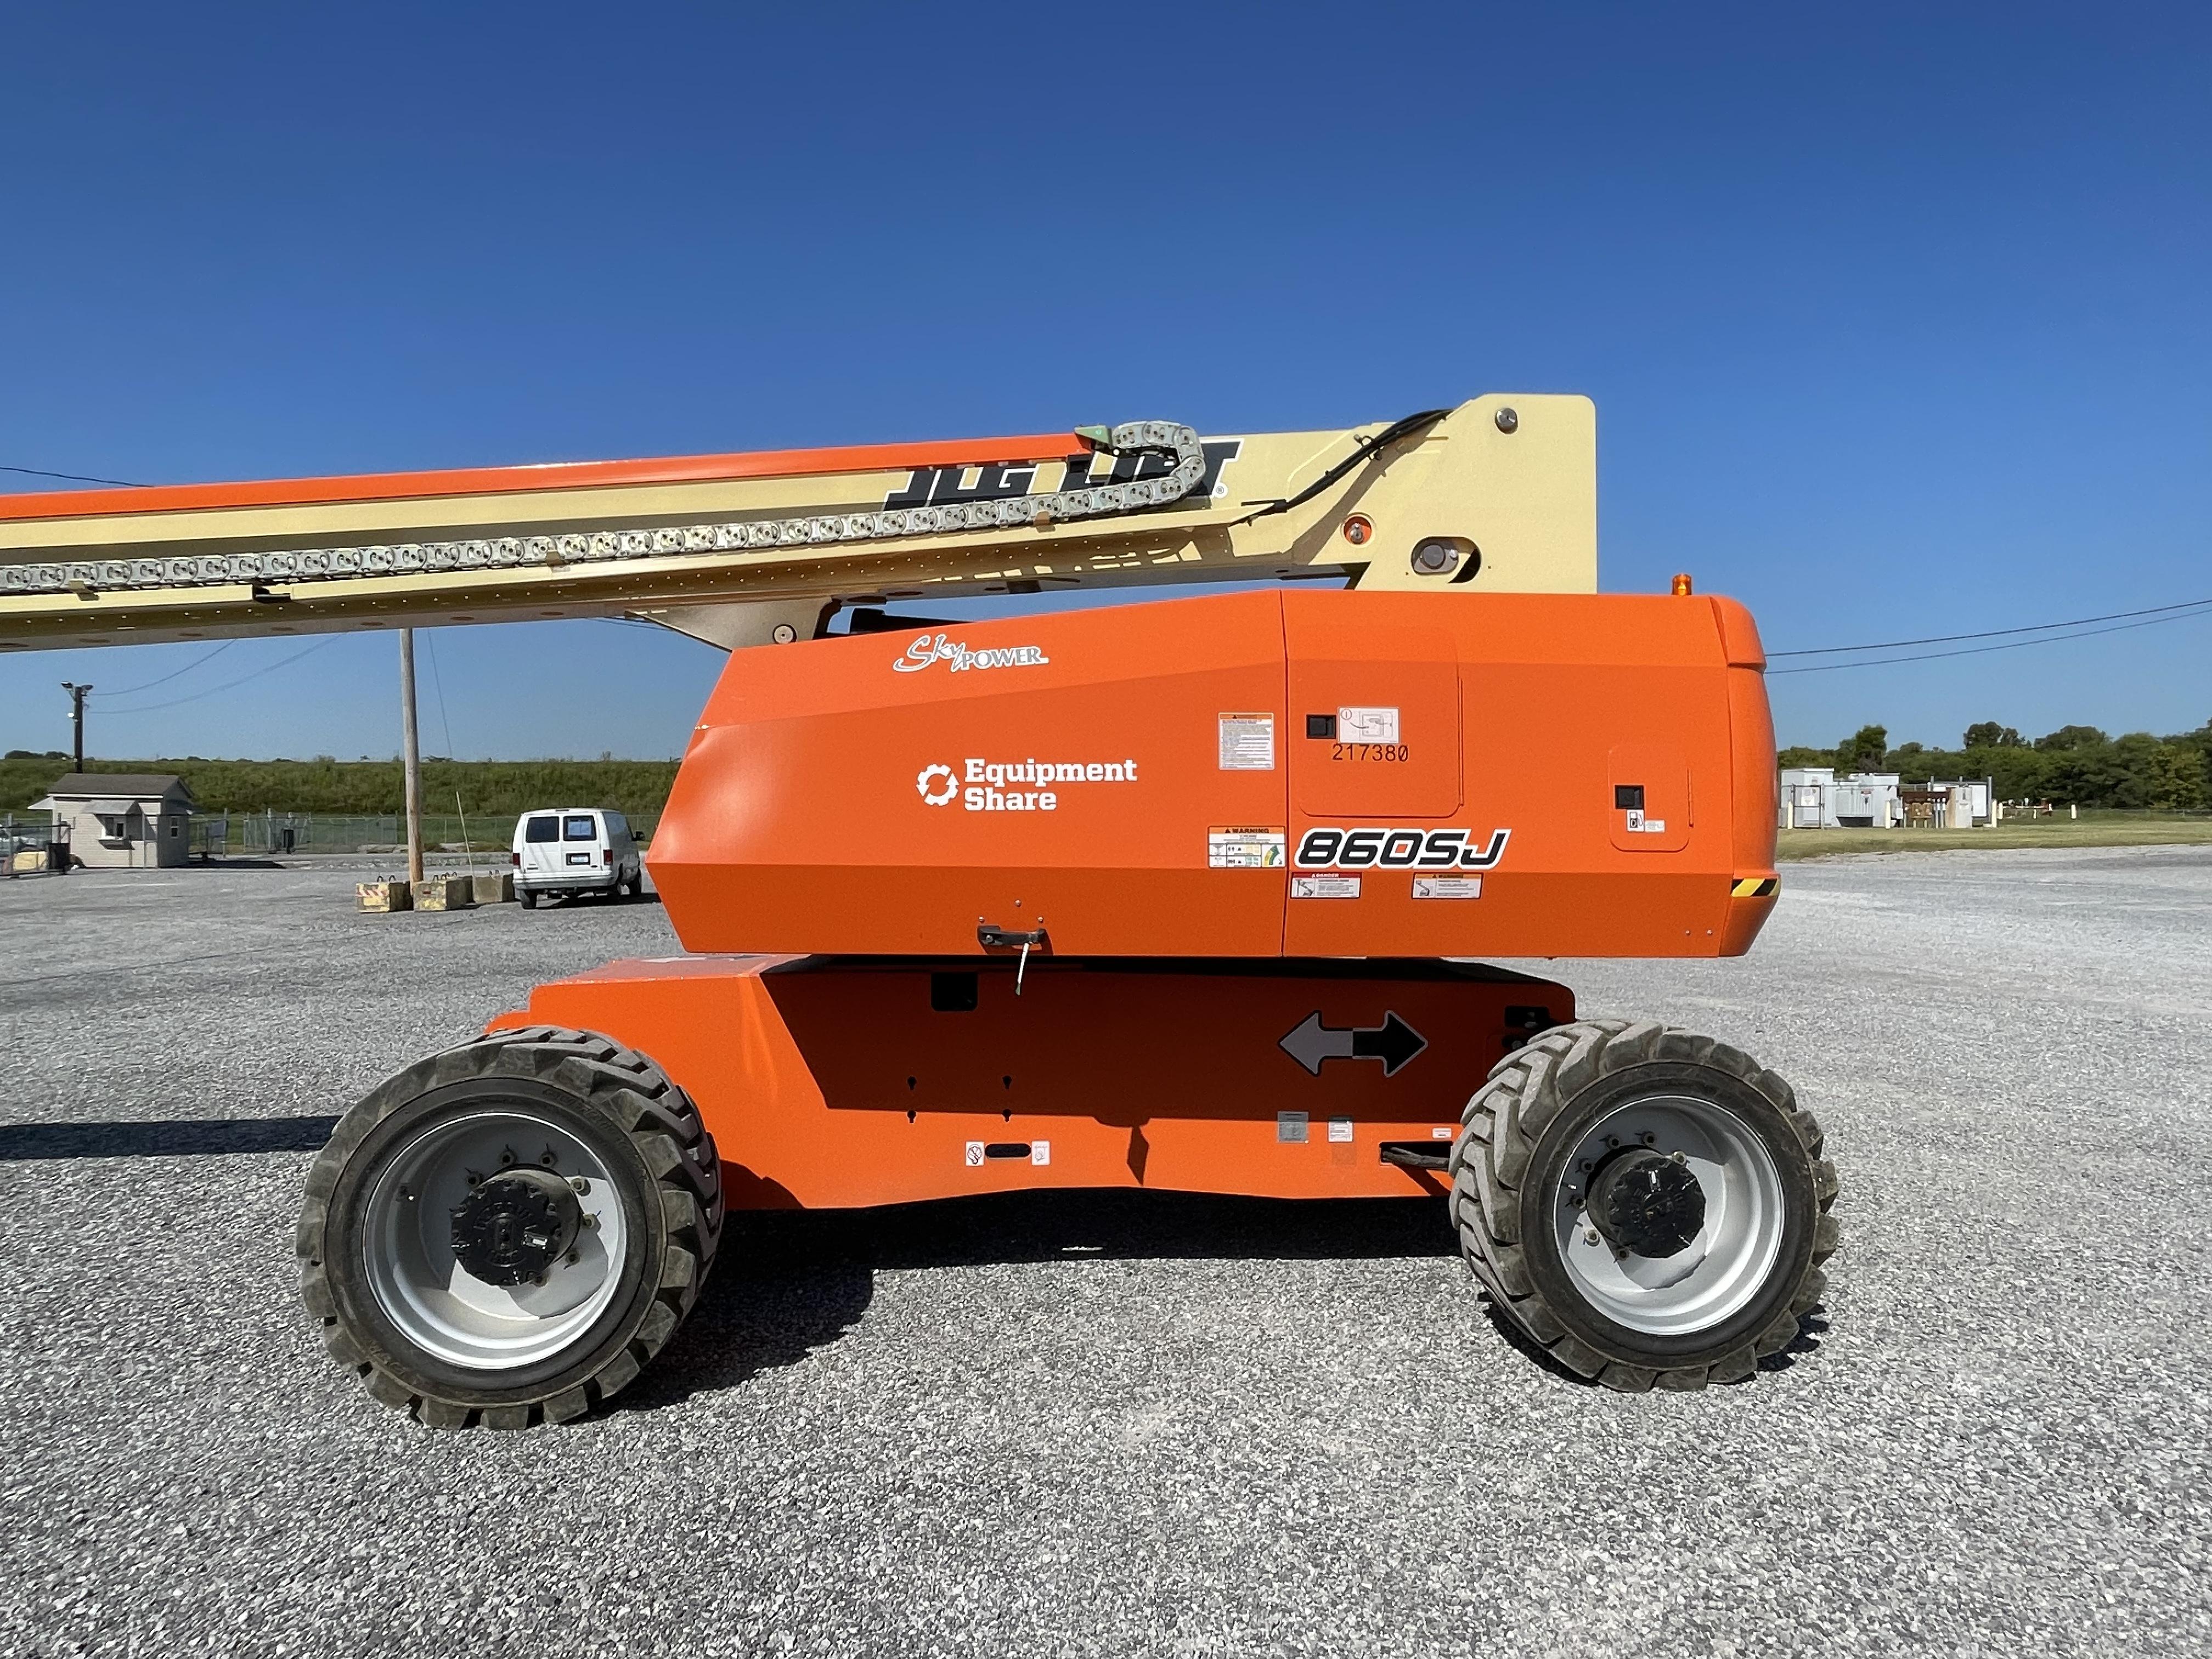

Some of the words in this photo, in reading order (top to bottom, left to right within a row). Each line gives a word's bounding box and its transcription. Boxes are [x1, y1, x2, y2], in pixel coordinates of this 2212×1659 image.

[882, 462, 1038, 510] JLG
[1332, 743, 1408, 762] 217380
[964, 758, 1138, 787] Equipment
[964, 787, 1057, 811] Share
[1296, 829, 1509, 868] 860SJ
